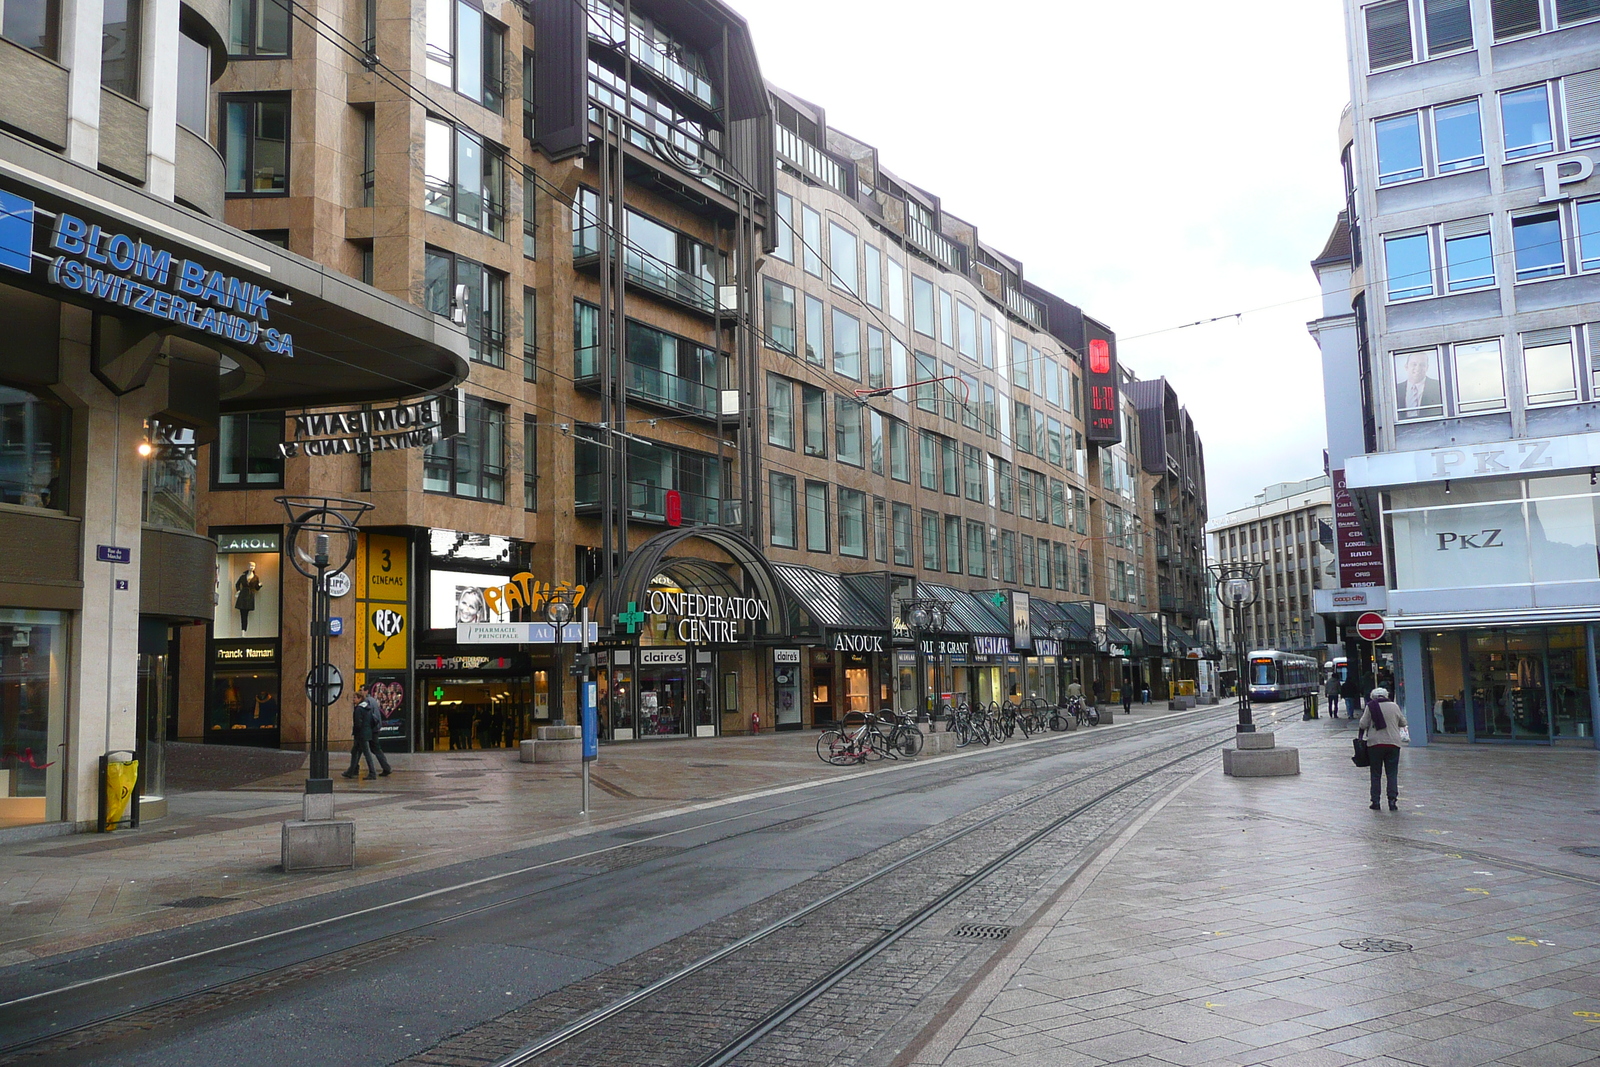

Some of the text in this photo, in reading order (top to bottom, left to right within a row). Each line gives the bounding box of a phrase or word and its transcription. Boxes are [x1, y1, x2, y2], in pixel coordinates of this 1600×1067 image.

[52, 213, 273, 322] BLOM BANK
[48, 255, 295, 358] (SWITZERLAND) SA
[1430, 440, 1553, 477] PKZ
[1436, 528, 1504, 551] PKZ
[381, 549, 392, 573] 3
[1350, 550, 1373, 558] RADO
[119, 580, 125, 589] 2
[371, 574, 404, 587] CINEMAS
[643, 590, 770, 621] CONFEDERATION
[1351, 594, 1365, 602] city
[375, 608, 402, 637] REX
[474, 626, 517, 634] PHARMACIE
[678, 618, 739, 643] CENTRE
[834, 634, 883, 653] ANOUK
[946, 641, 969, 654] GRANT
[216, 648, 274, 659] Franck Namani
[643, 651, 684, 663] claire's
[777, 651, 798, 661] claire's
